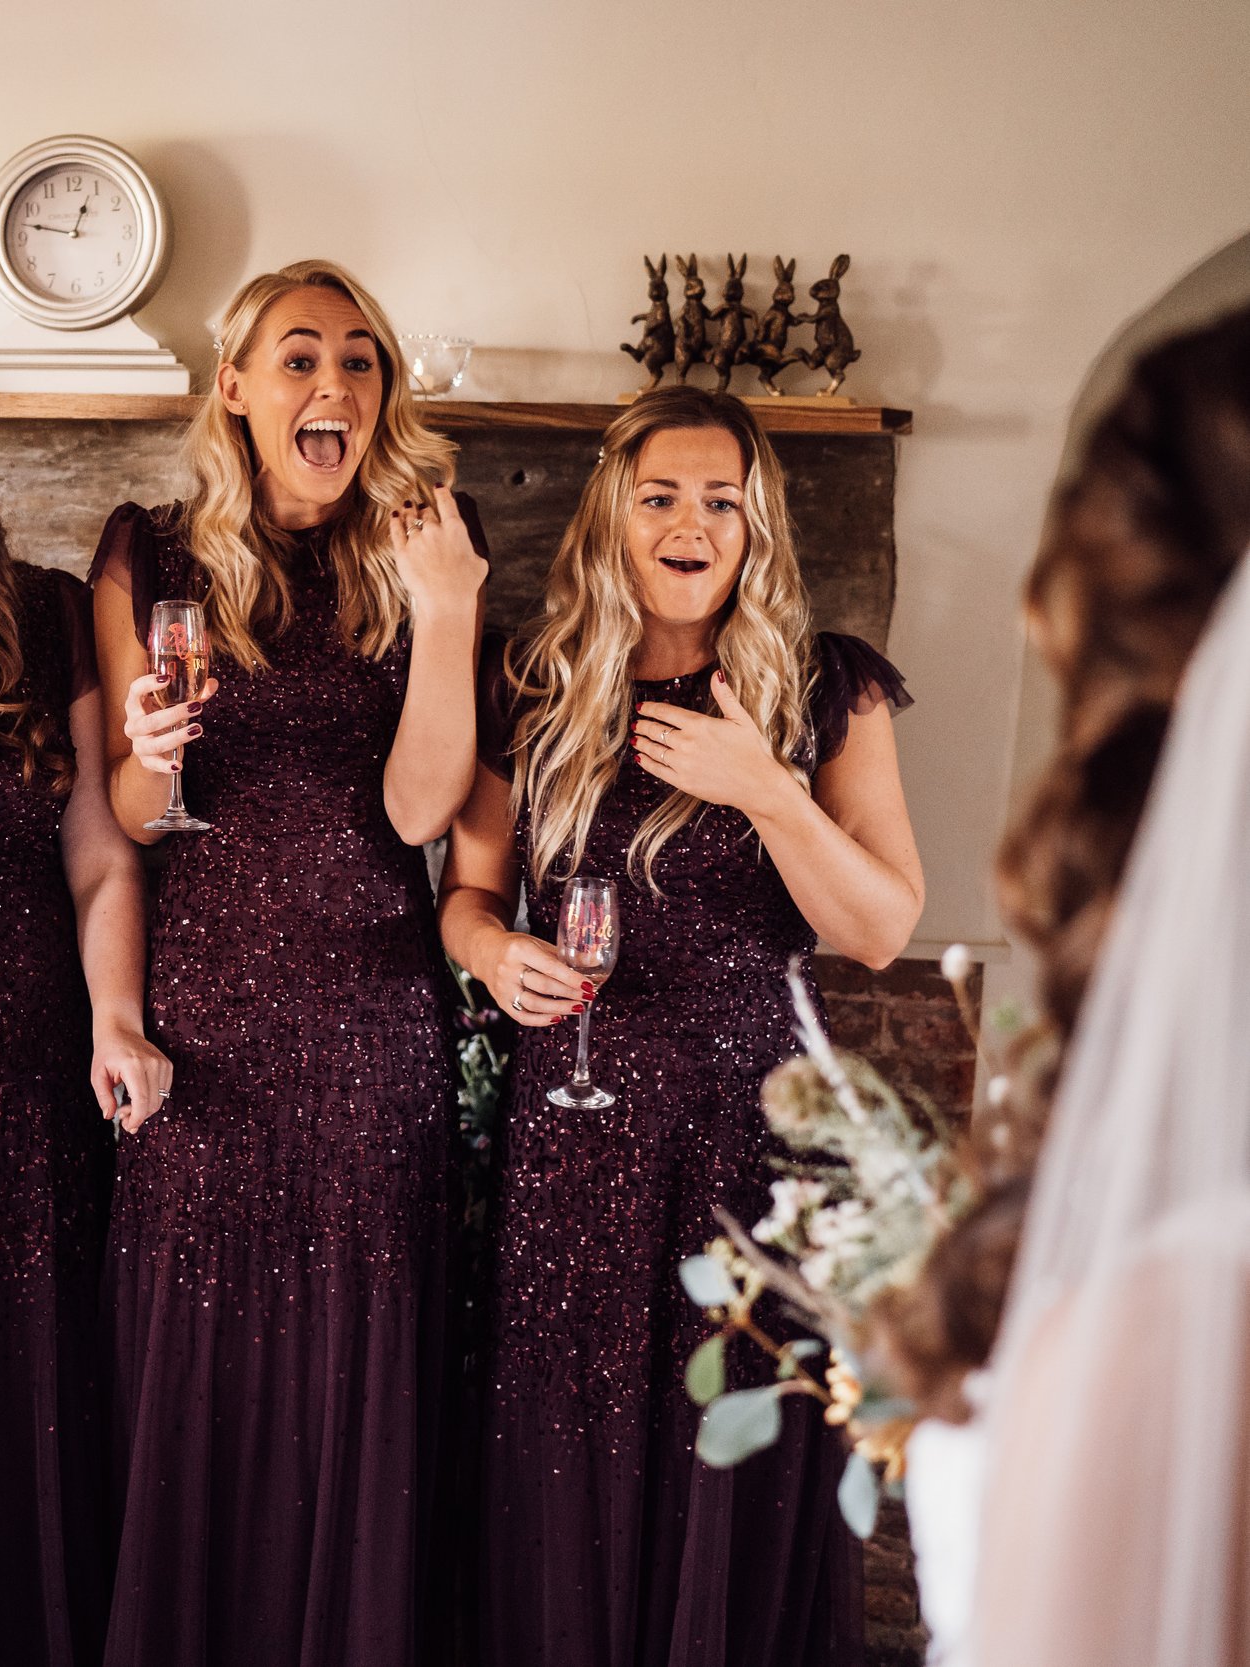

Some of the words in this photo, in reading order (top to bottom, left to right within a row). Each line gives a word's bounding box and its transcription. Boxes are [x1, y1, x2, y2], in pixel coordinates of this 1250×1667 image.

[44, 183, 55, 199] 11
[66, 176, 82, 192] 12
[94, 180, 100, 196] 1
[26, 202, 40, 217] 10
[111, 196, 120, 211] 2
[18, 231, 27, 247] 9
[122, 224, 132, 240] 3
[27, 255, 37, 272] 8
[114, 252, 122, 267] 4
[47, 273, 56, 288] 7
[71, 278, 81, 294] 6
[94, 272, 104, 287] 5
